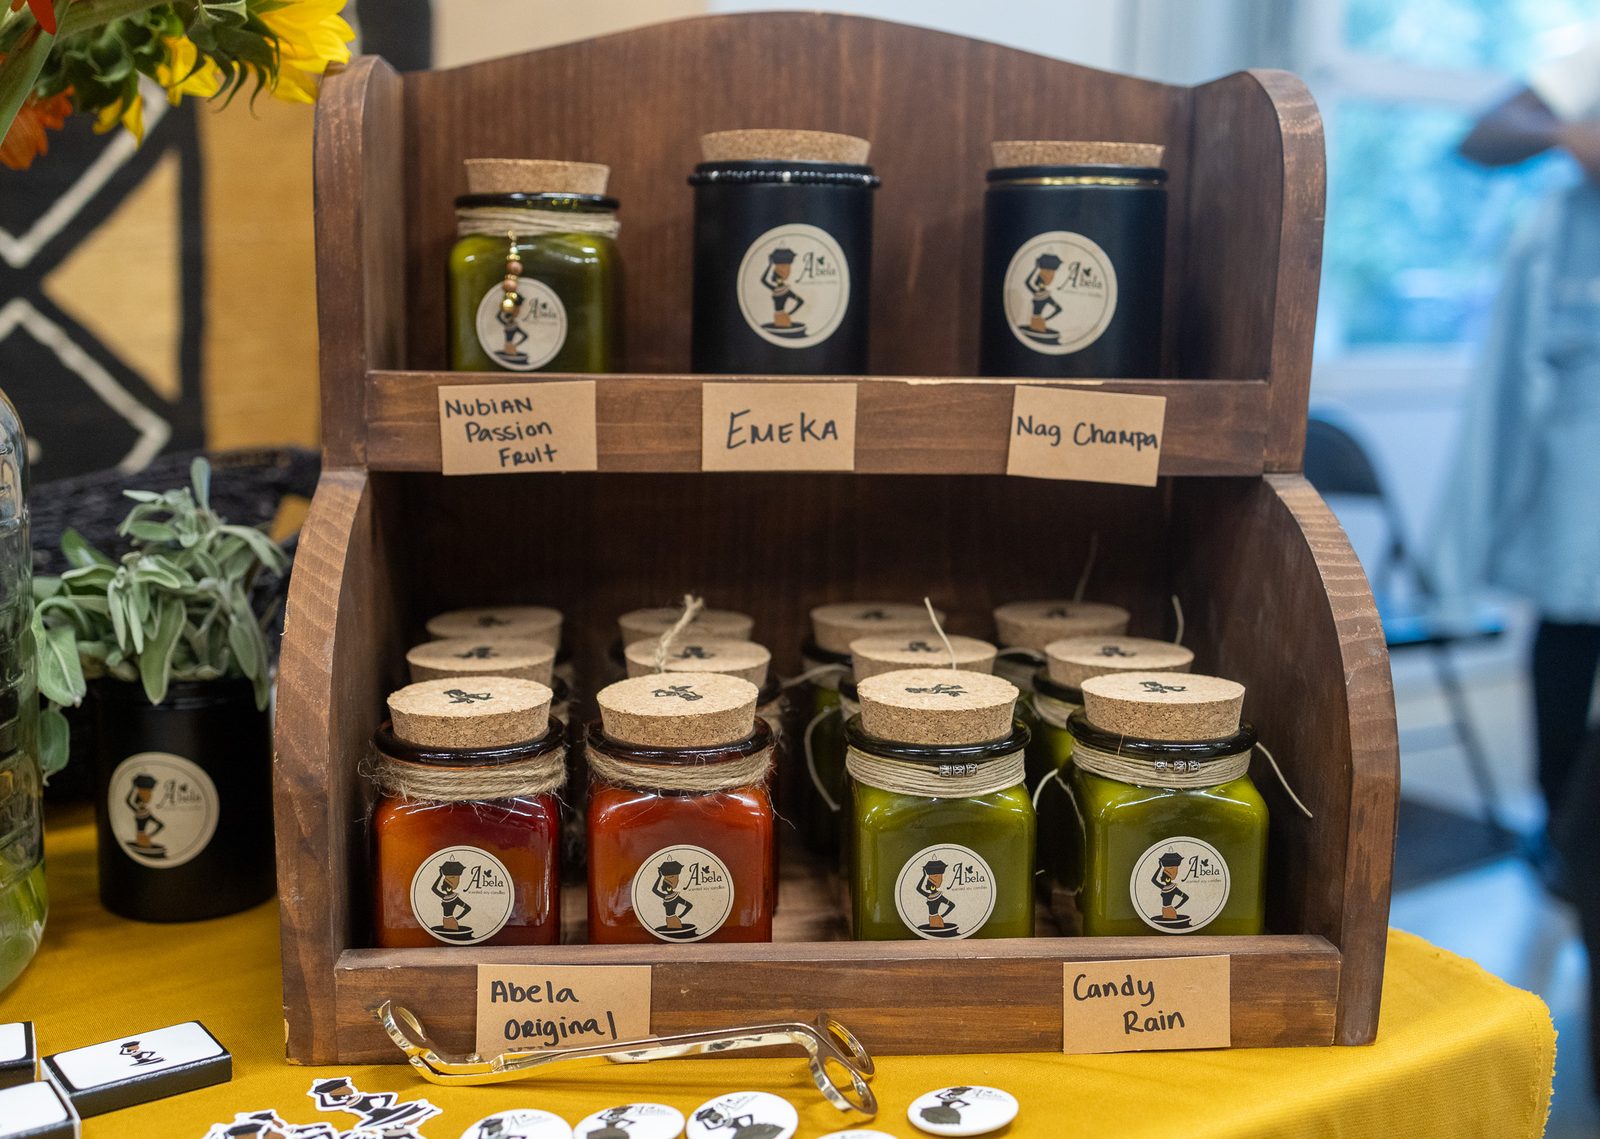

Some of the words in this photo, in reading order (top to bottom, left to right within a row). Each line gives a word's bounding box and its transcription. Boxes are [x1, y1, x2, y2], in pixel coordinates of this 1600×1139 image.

[465, 421, 552, 443] Passion
[727, 409, 838, 449] EMEKA
[1017, 415, 1061, 446] Nag
[463, 865, 504, 892] Abela
[683, 862, 722, 890] Abela
[946, 862, 985, 890] Abela
[1181, 855, 1220, 882] Abela
[491, 980, 579, 1003] Abela
[1073, 974, 1155, 1007] Candy
[1123, 1010, 1185, 1034] Rain
